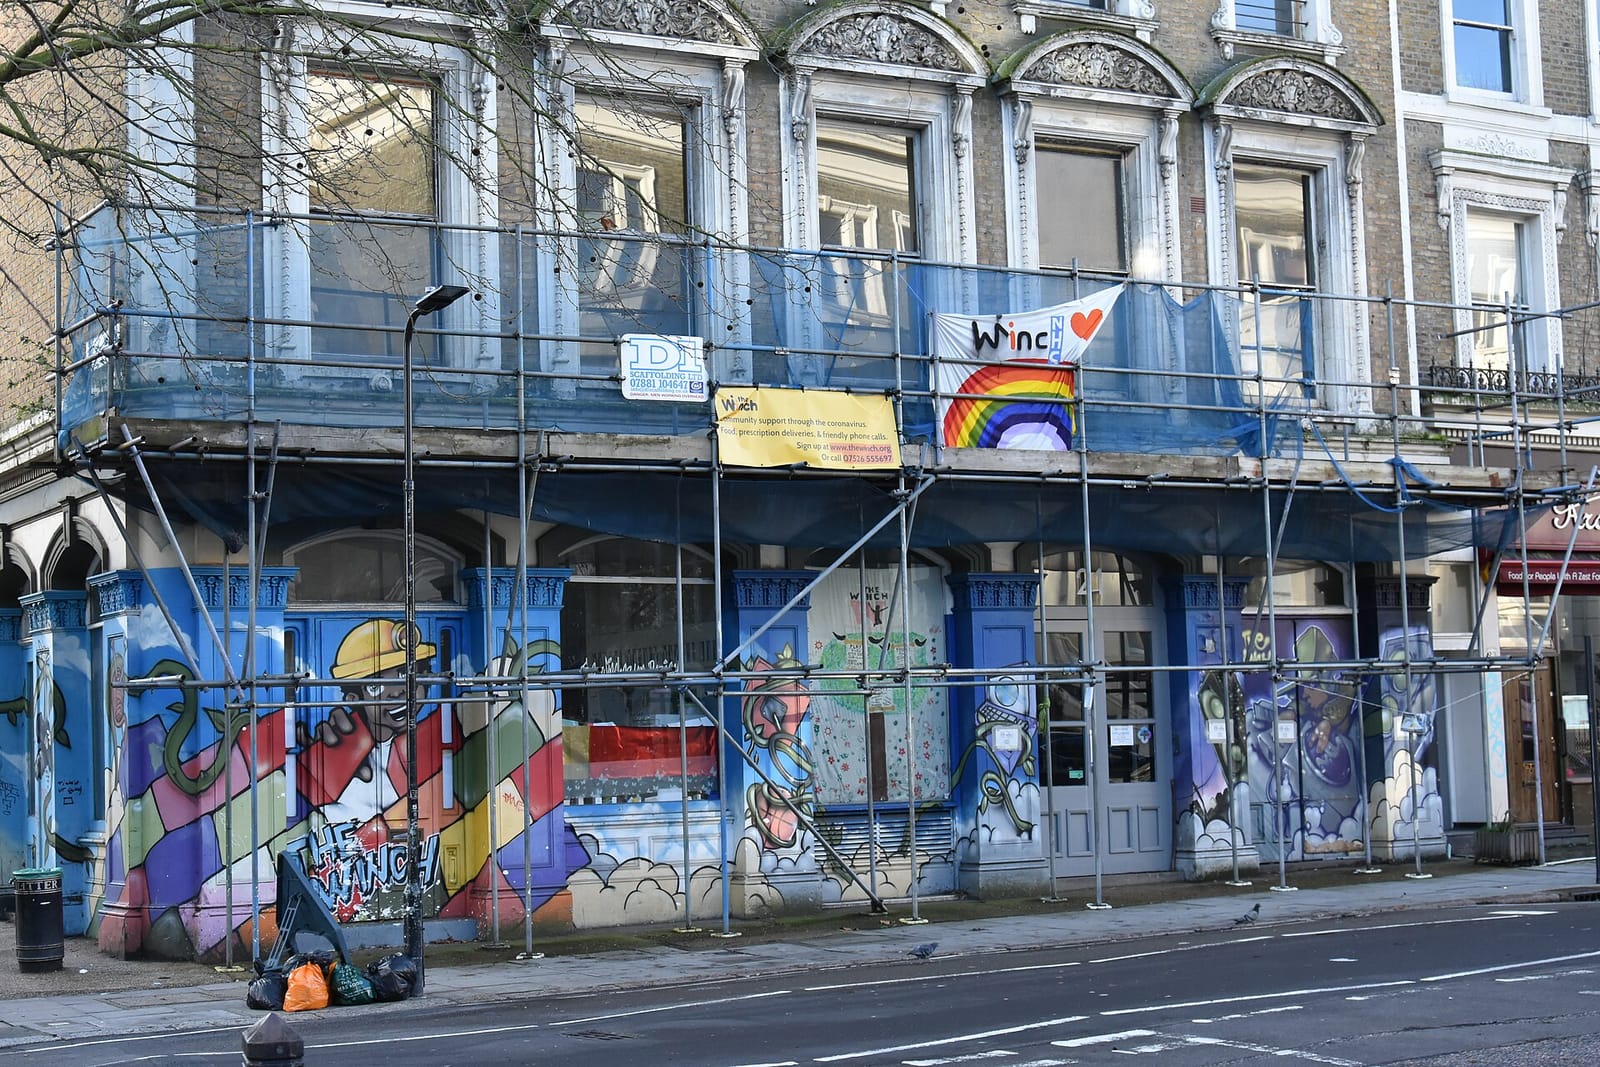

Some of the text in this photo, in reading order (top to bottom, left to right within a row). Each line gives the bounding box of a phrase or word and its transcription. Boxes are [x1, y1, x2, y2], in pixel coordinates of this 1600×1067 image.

[630, 371, 703, 381] SCAFFOLDING LTD
[630, 379, 688, 389] 07881 104647
[722, 415, 758, 425] ommunity
[758, 418, 787, 426] support
[787, 418, 814, 427] through
[738, 428, 780, 438] prescription
[822, 431, 848, 440] friendly
[849, 432, 870, 441] phone
[796, 441, 812, 451] Sign
[821, 453, 892, 463] Or call 07526 555697
[1508, 571, 1523, 580] Food
[1534, 571, 1556, 582] People
[1572, 572, 1578, 580] A
[1578, 572, 1591, 580] Zest
[849, 591, 889, 601] WNCH
